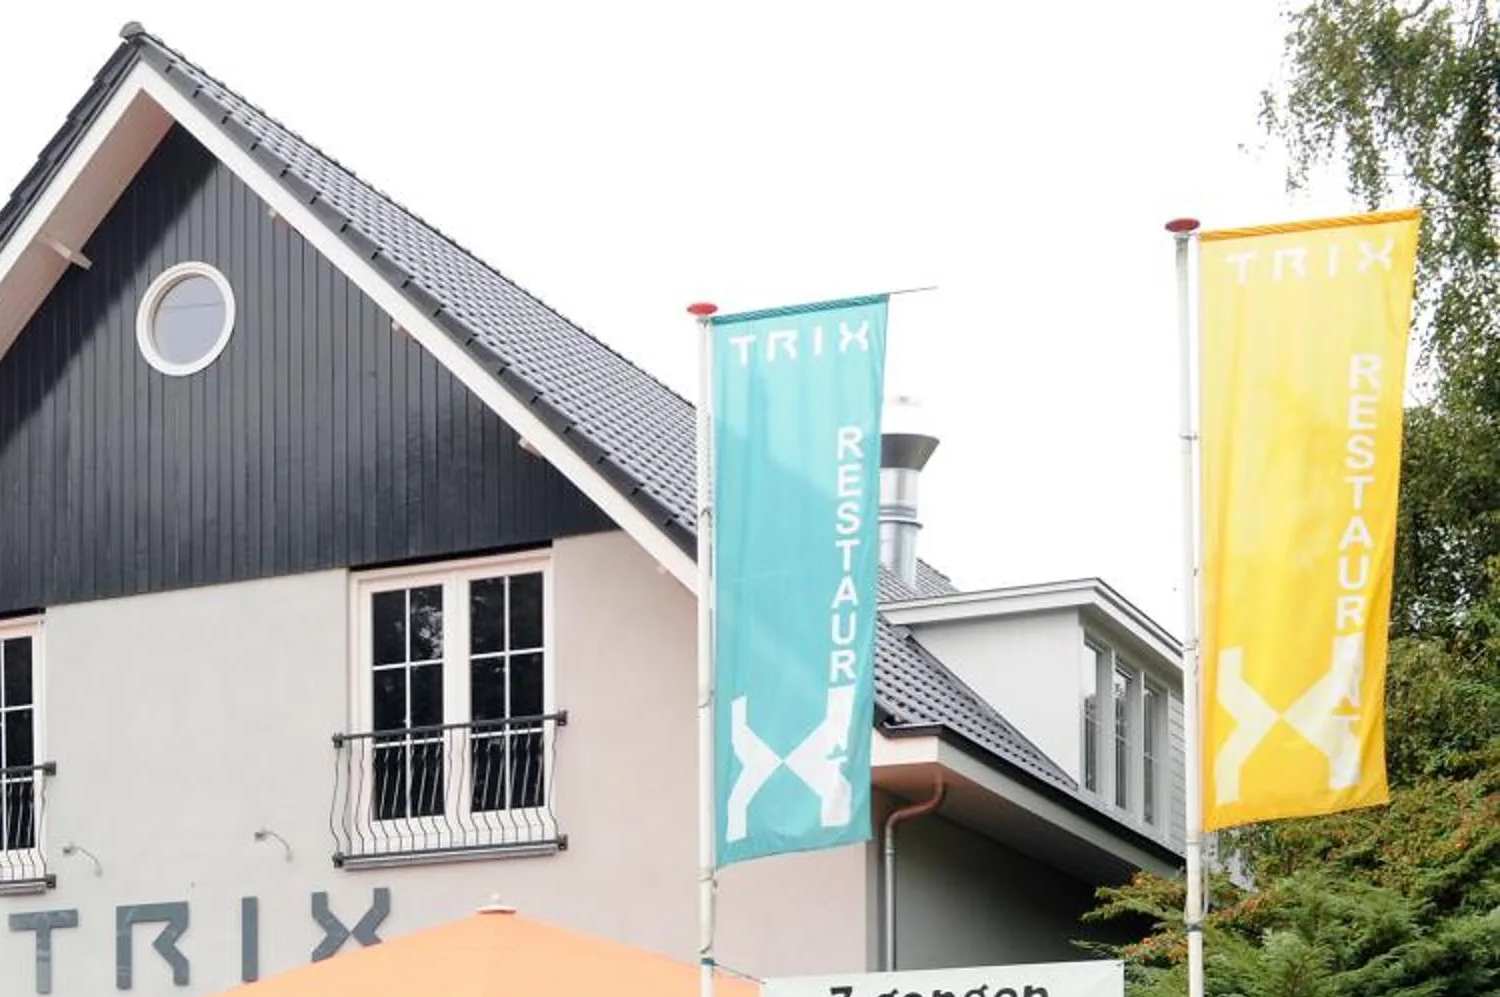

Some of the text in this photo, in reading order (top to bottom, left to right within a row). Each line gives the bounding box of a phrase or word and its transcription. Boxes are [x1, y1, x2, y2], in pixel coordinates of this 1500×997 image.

[1225, 235, 1395, 286] TRIX
[728, 320, 870, 368] TRIX
[8, 887, 391, 995] TRIX
